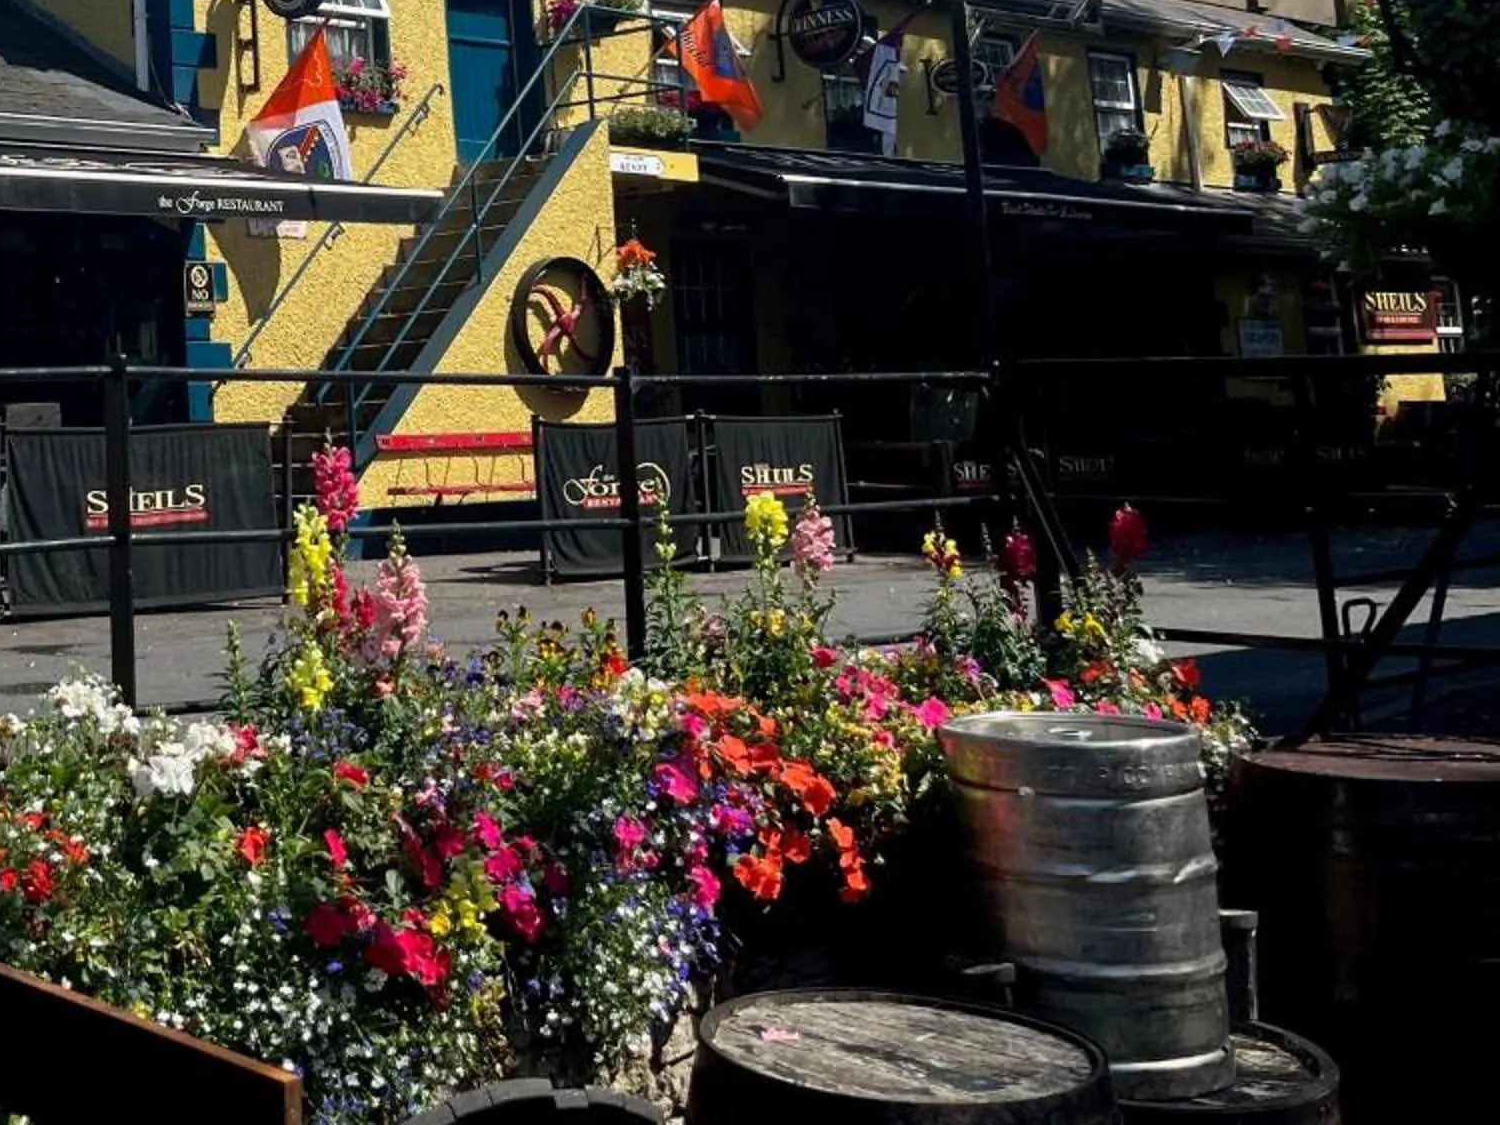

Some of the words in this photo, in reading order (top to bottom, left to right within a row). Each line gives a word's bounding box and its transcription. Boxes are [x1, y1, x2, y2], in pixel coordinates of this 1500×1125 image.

[158, 194, 173, 208] the
[175, 190, 215, 214] Forge
[217, 197, 285, 213] RESTAURANT
[1364, 291, 1427, 312] SHEILS
[86, 484, 206, 514] SEILS
